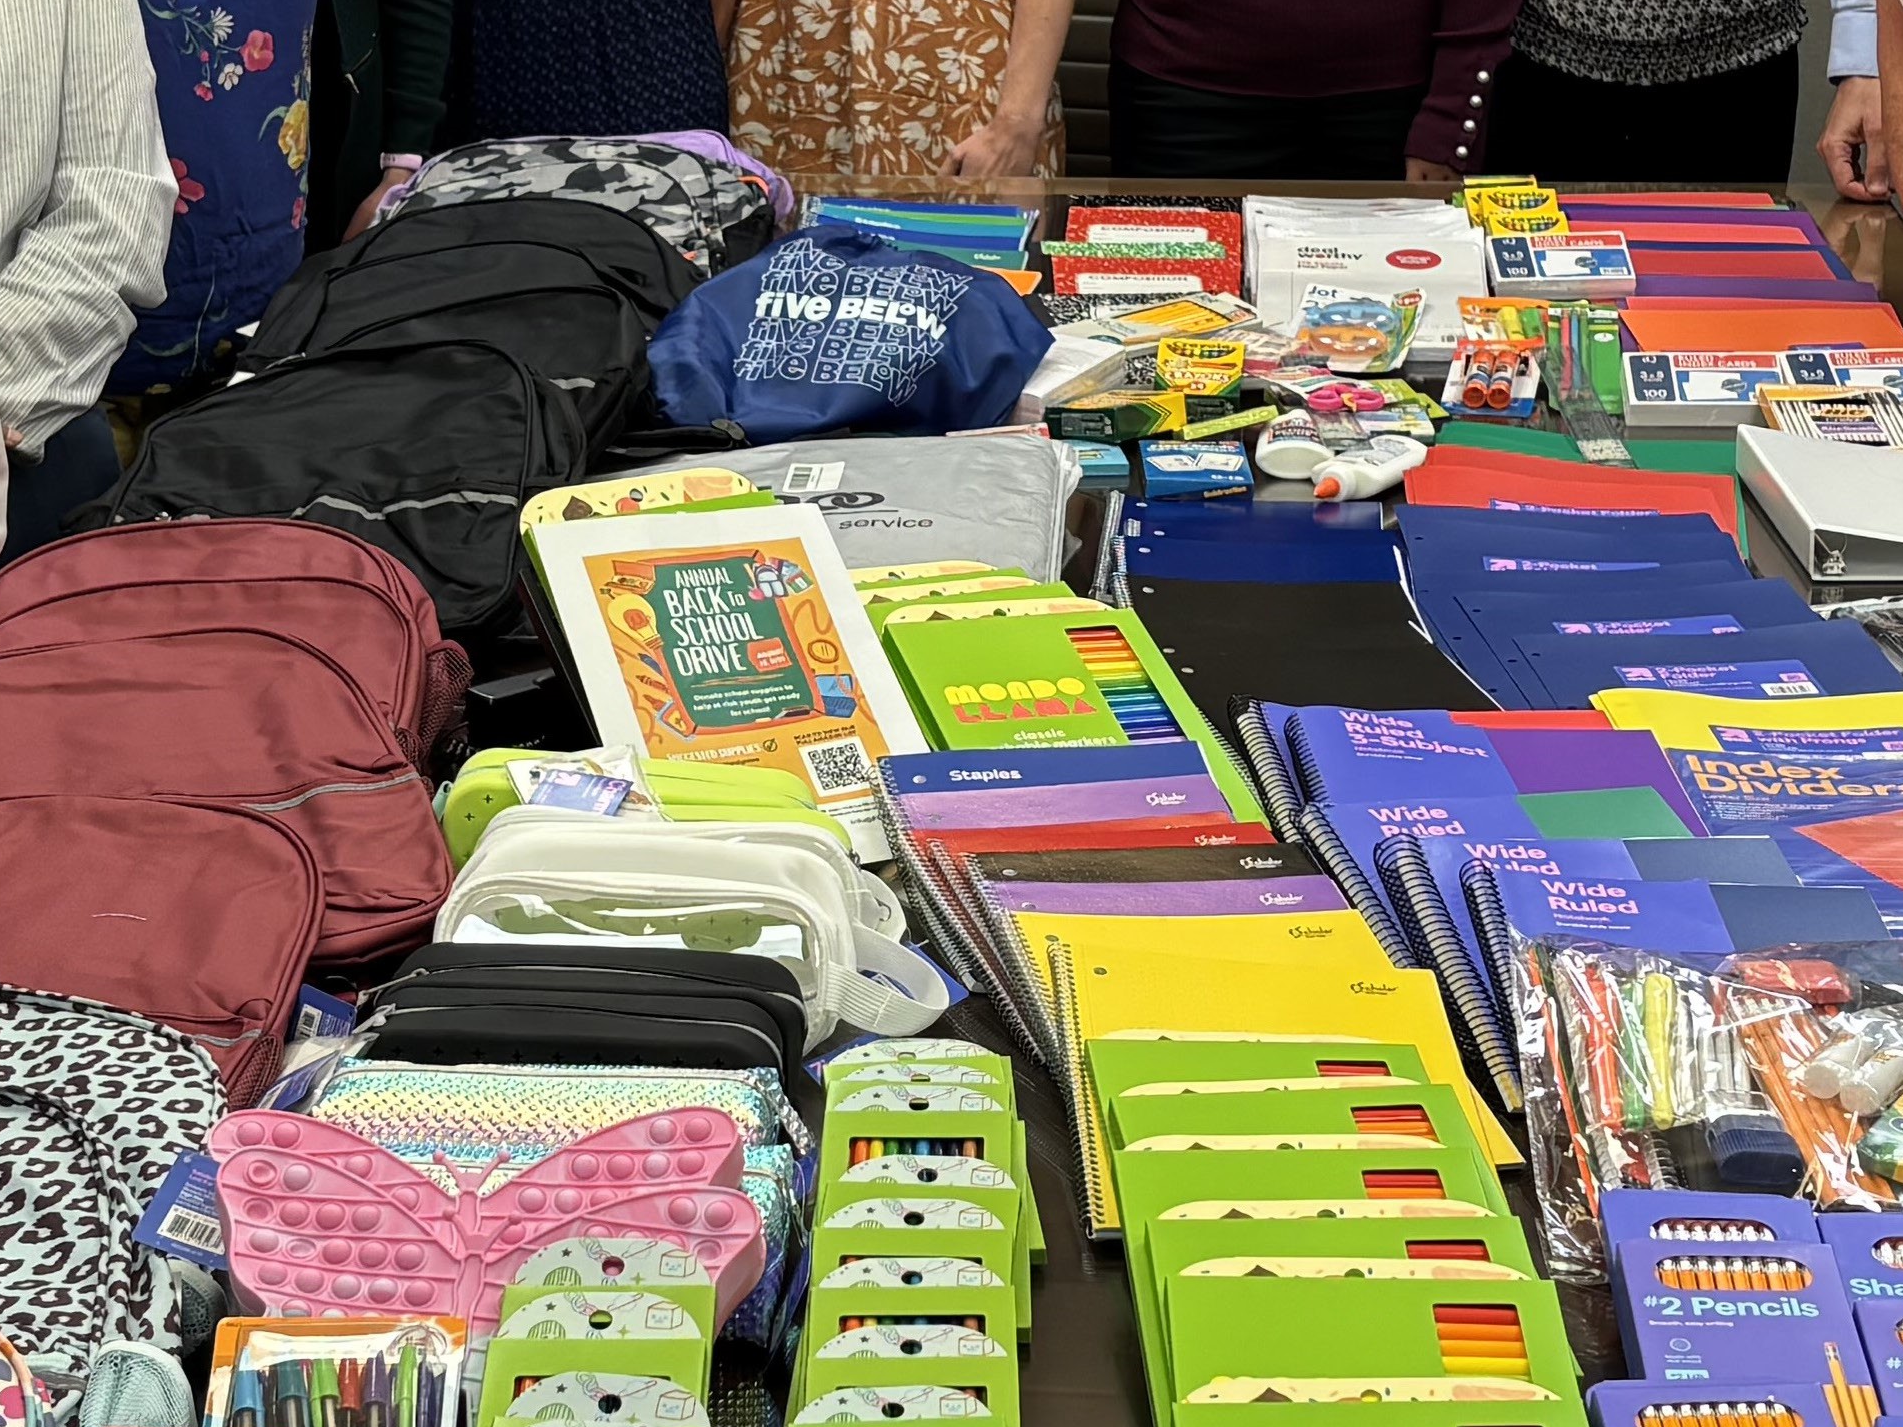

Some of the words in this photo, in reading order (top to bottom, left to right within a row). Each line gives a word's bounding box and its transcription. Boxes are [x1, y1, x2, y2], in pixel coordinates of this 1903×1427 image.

[675, 567, 734, 588] ANNUAL
[663, 587, 728, 618] BACK
[670, 613, 764, 647] SCHOOL
[673, 642, 747, 676] DRIVE
[944, 677, 1086, 704] MONDO
[954, 697, 1096, 722] LLAMA
[1339, 710, 1414, 728] Wide
[1013, 727, 1066, 741] classic
[1345, 721, 1425, 741] Ruled
[1349, 733, 1489, 759] 3-Subject
[949, 768, 1023, 783] Staples
[1685, 756, 1845, 781] Index
[1540, 879, 1627, 898] Wide
[1547, 897, 1642, 914] Ruled
